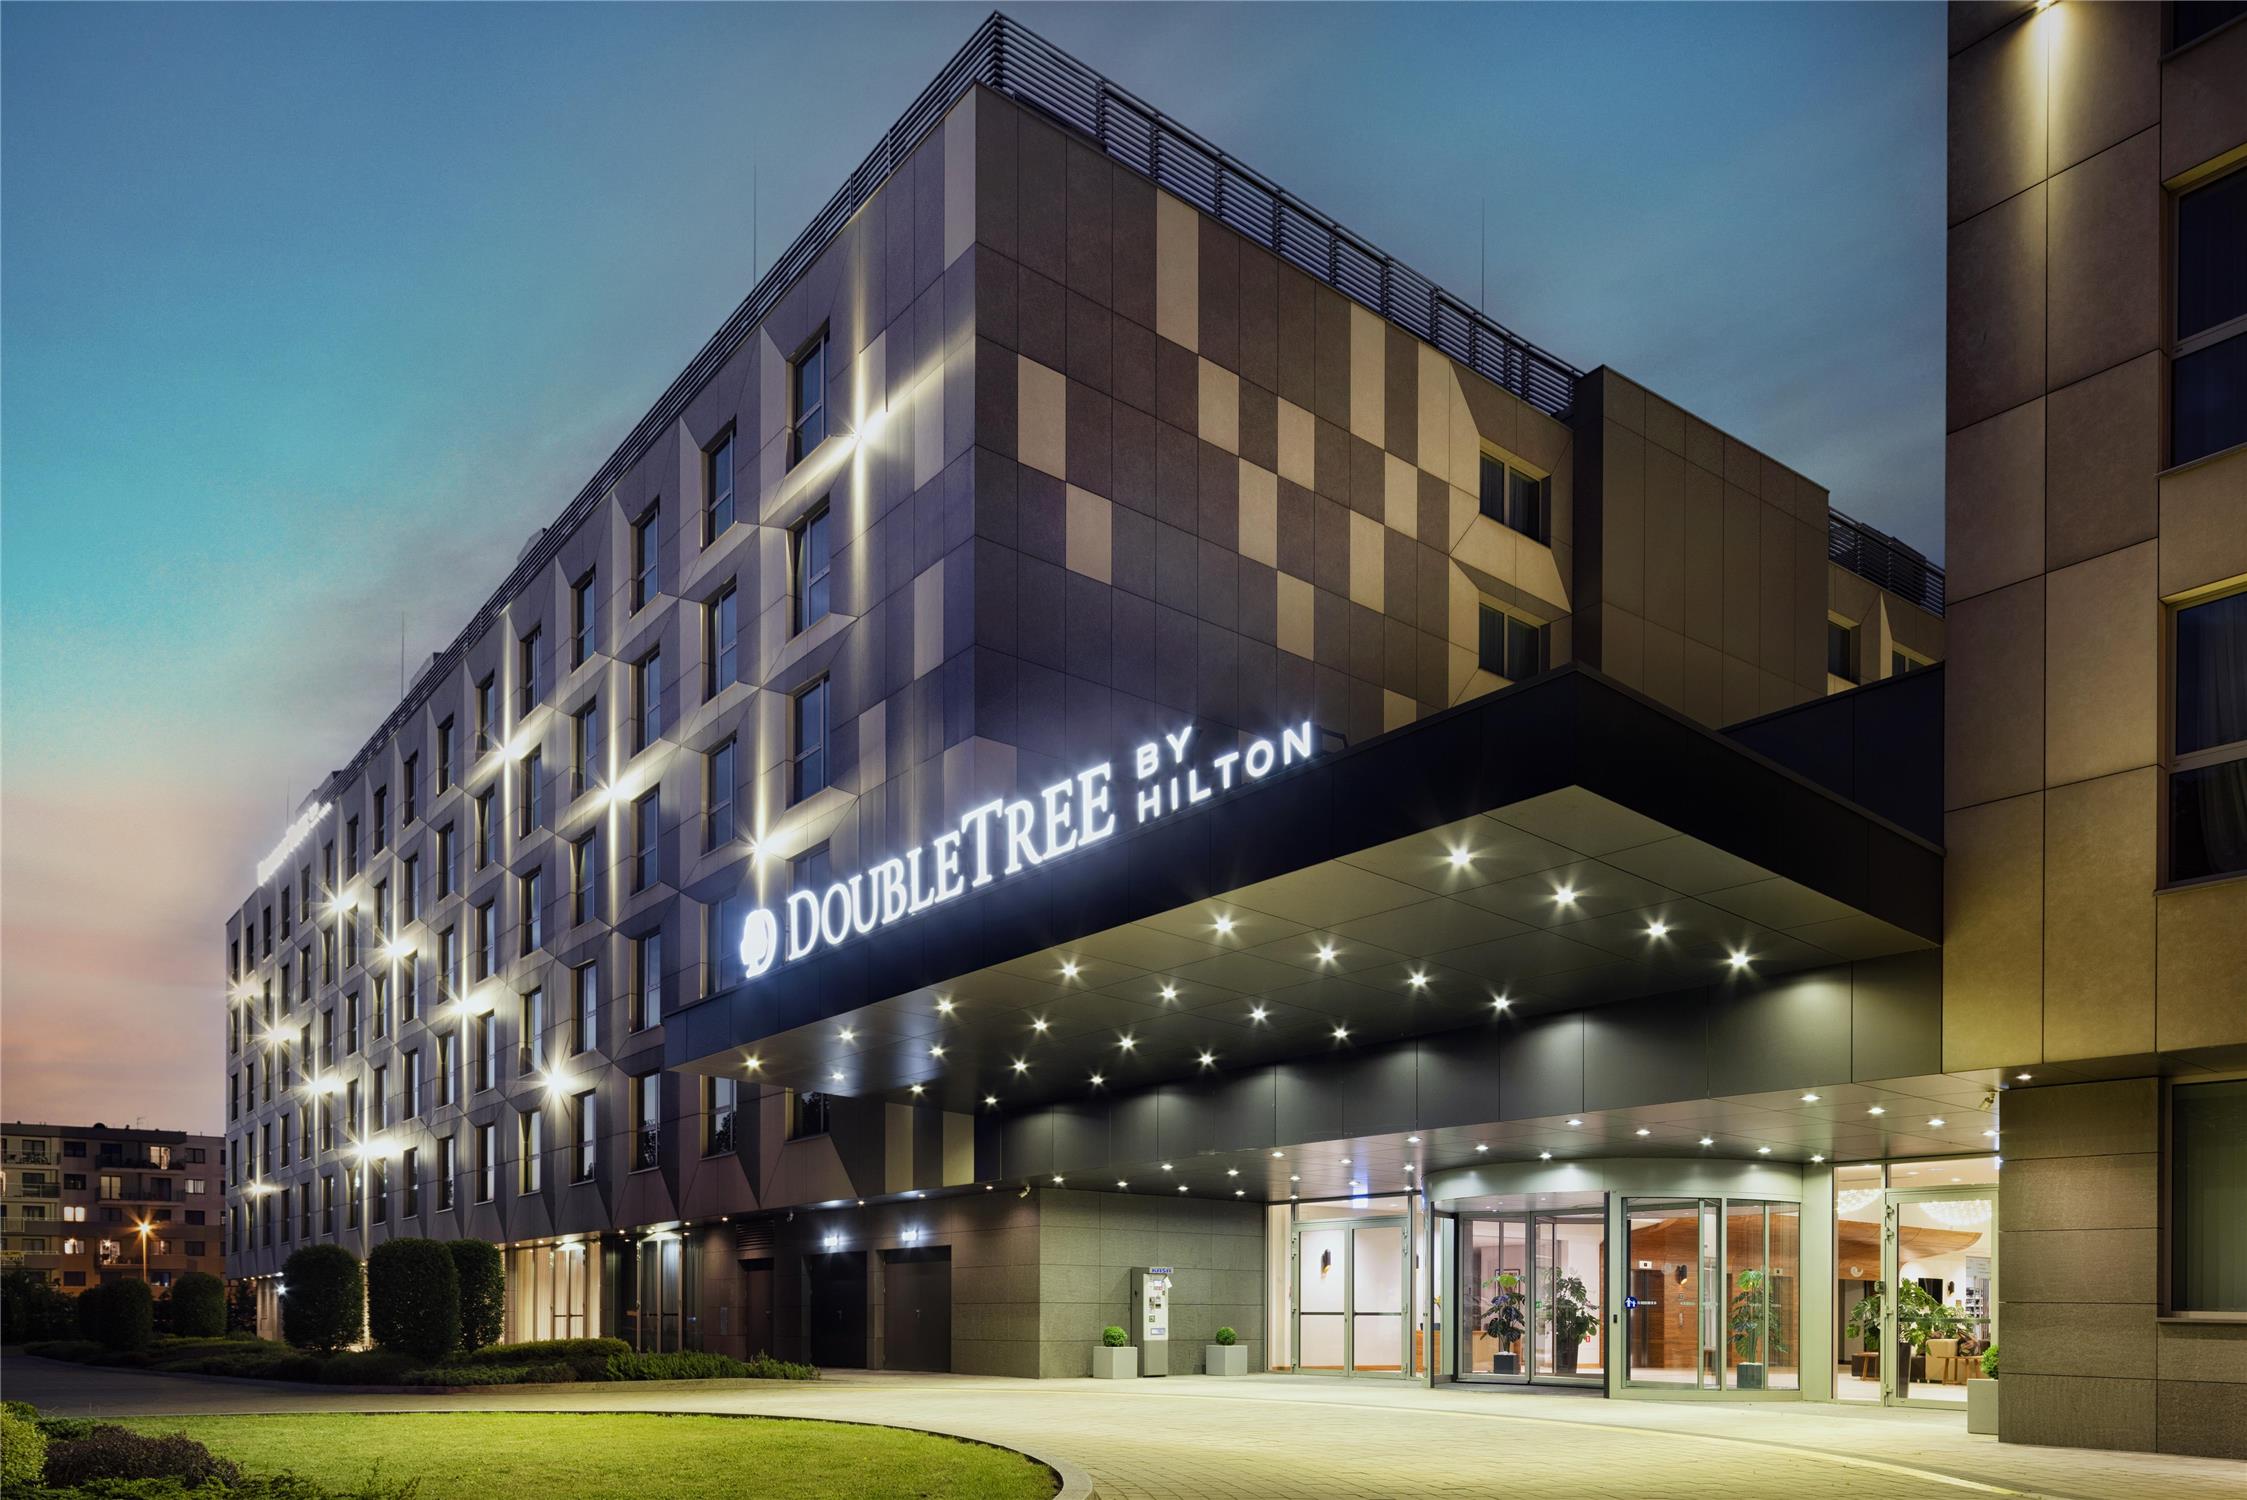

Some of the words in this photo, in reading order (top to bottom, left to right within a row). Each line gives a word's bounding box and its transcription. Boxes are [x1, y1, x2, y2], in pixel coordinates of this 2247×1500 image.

[1137, 726, 1192, 779] BY
[1138, 722, 1311, 823] HILTON
[786, 763, 1115, 960] DOUBLETREE
